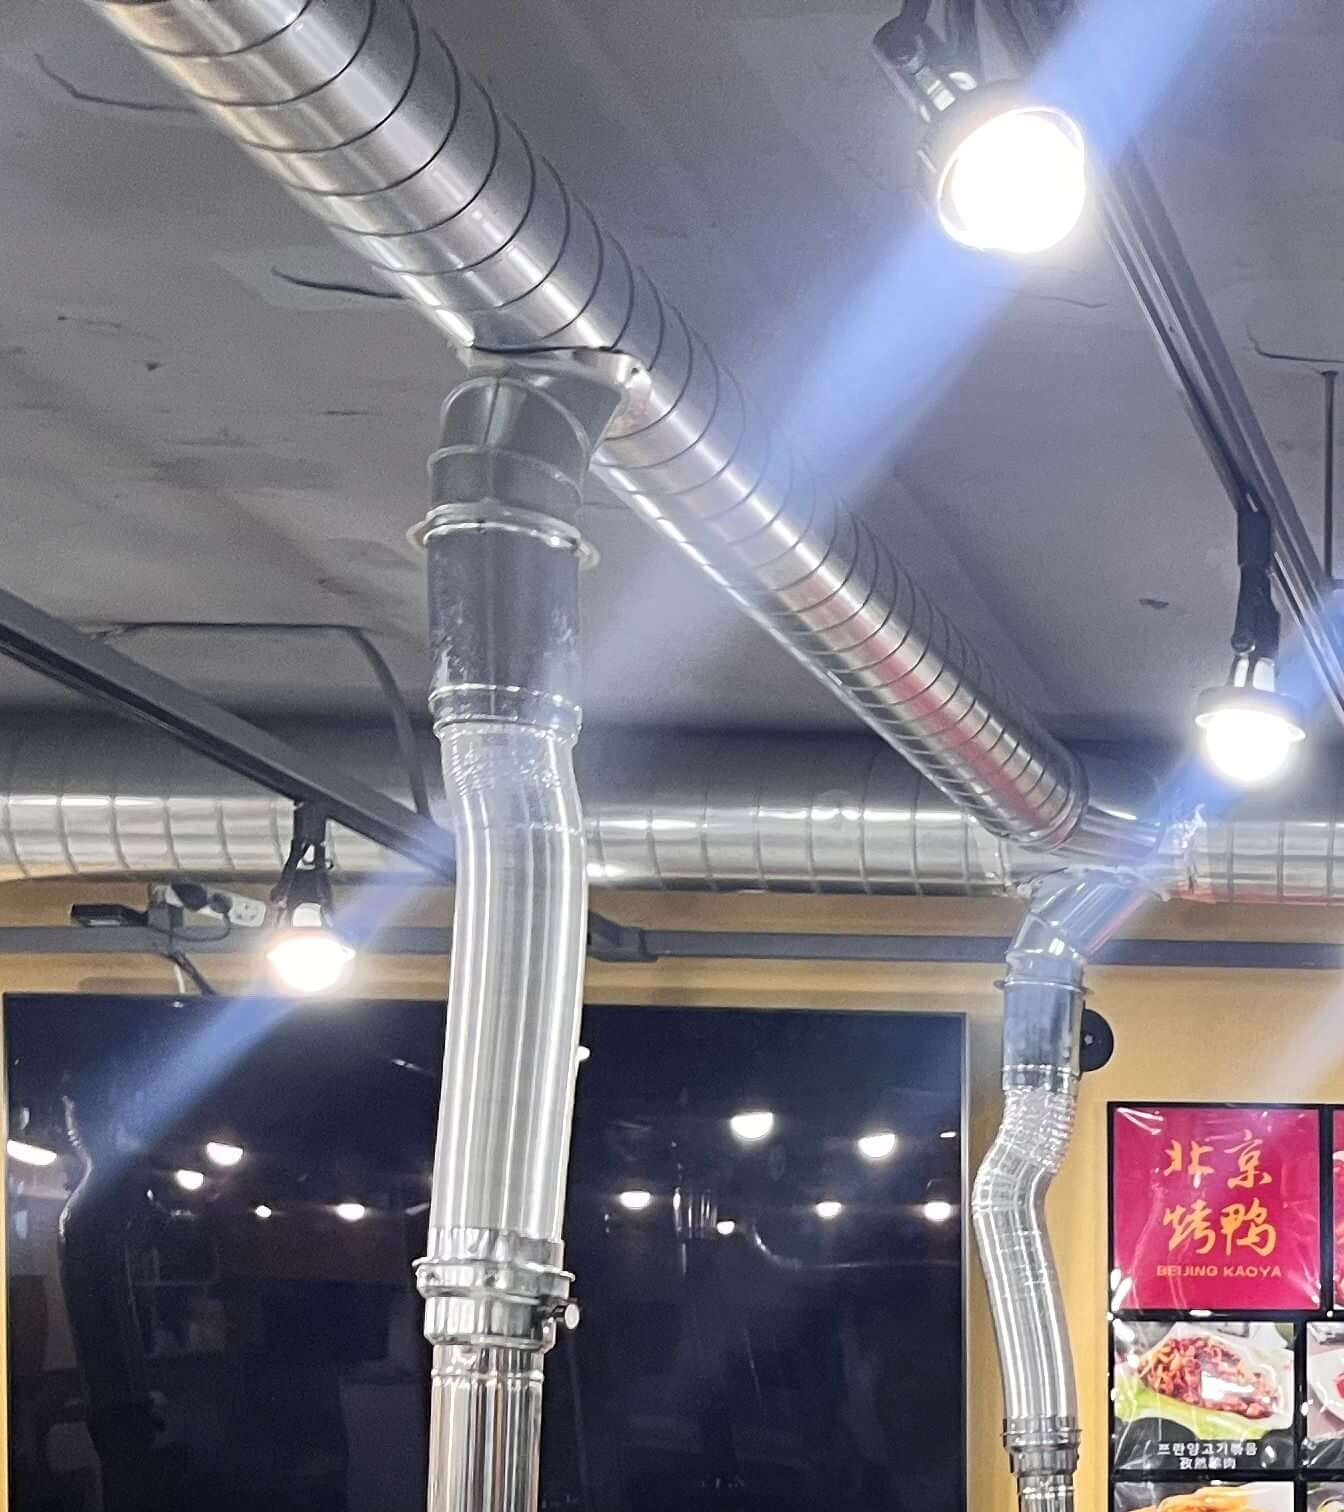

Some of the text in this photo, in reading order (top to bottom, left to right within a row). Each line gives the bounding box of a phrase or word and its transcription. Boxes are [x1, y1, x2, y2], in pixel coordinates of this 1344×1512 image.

[1163, 1129, 1273, 1189] 北京
[1163, 1197, 1277, 1257] 烤鸭
[1156, 1265, 1281, 1277] BEIJING KAOYA
